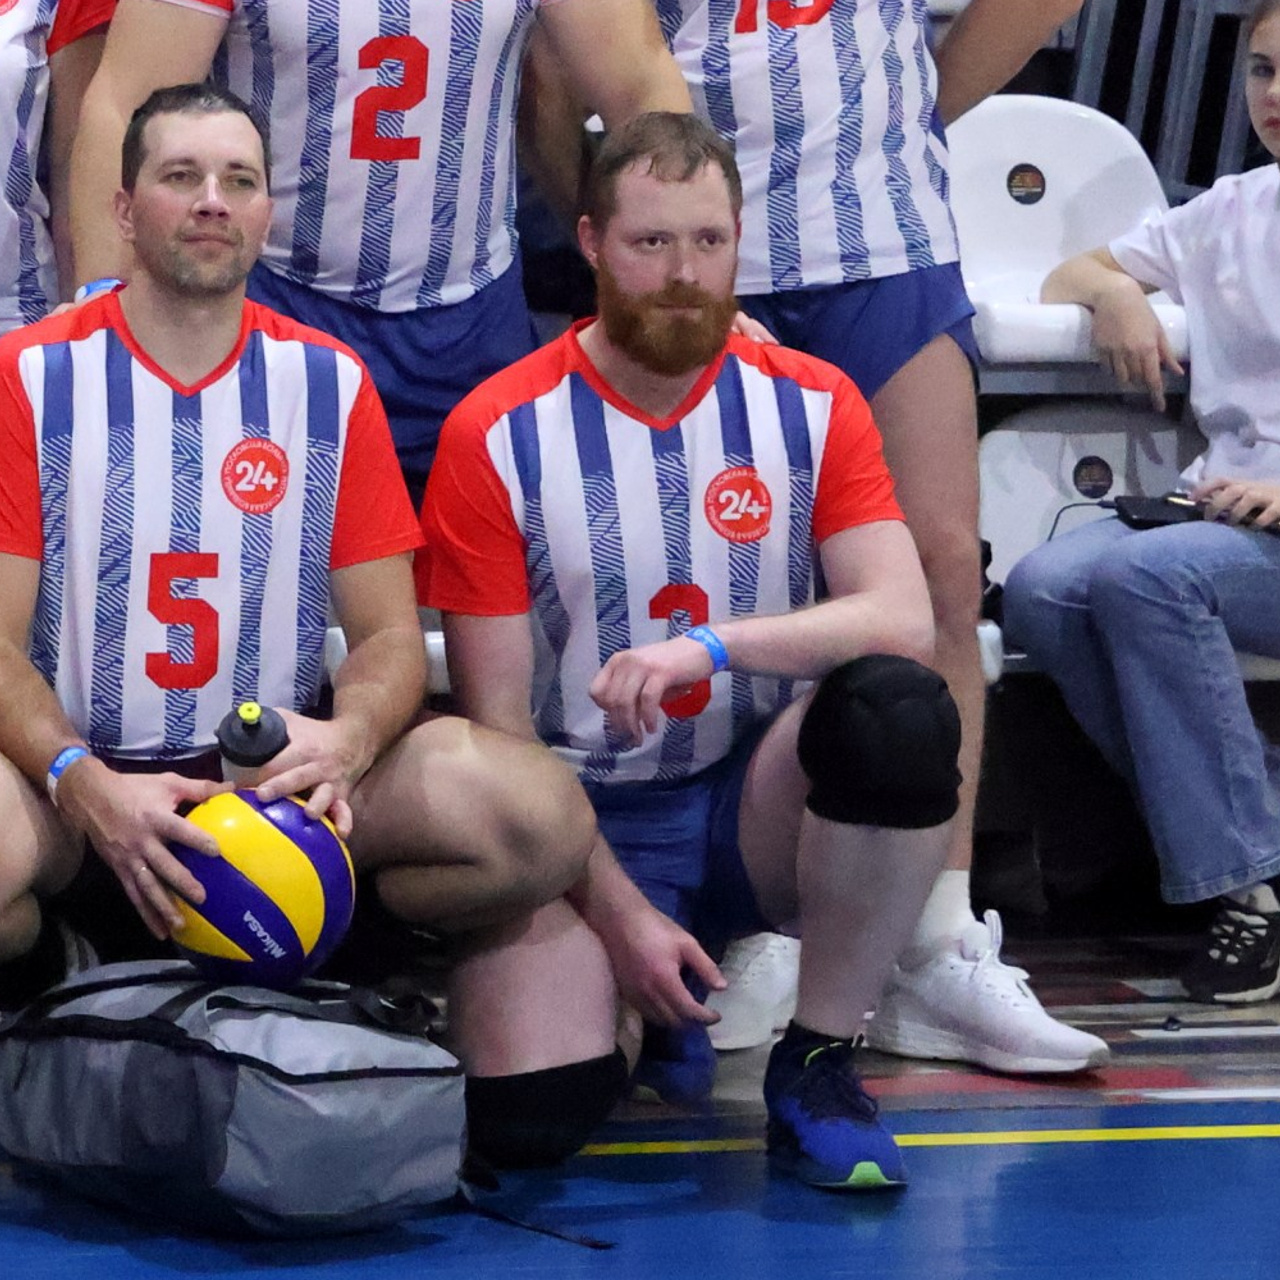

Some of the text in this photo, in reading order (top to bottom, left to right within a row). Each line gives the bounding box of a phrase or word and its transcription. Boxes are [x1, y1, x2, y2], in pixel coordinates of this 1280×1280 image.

[349, 35, 430, 160] 2
[234, 460, 279, 492] 24
[145, 552, 220, 689] 5
